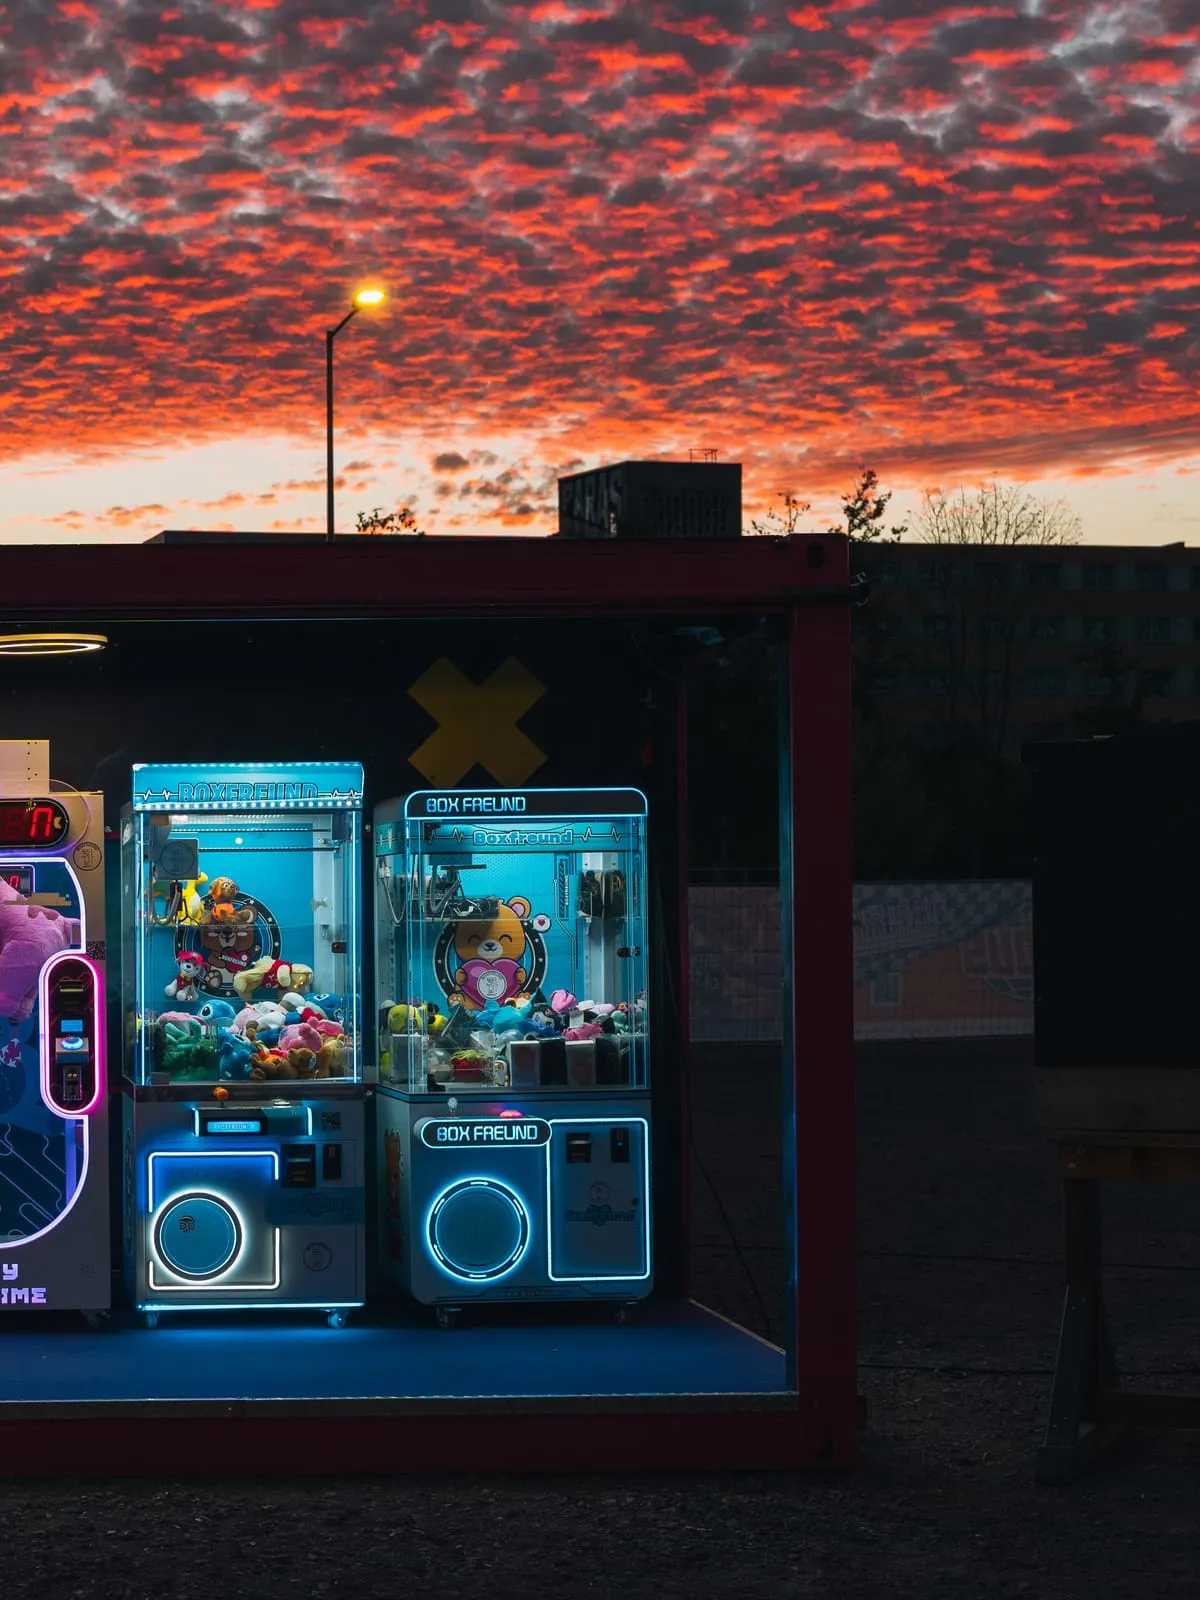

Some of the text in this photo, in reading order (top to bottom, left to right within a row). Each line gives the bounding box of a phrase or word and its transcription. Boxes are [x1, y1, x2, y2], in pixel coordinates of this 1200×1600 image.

[426, 797, 459, 813] BOX
[473, 829, 574, 846] Boxfreund
[437, 1126, 470, 1142] BOX
